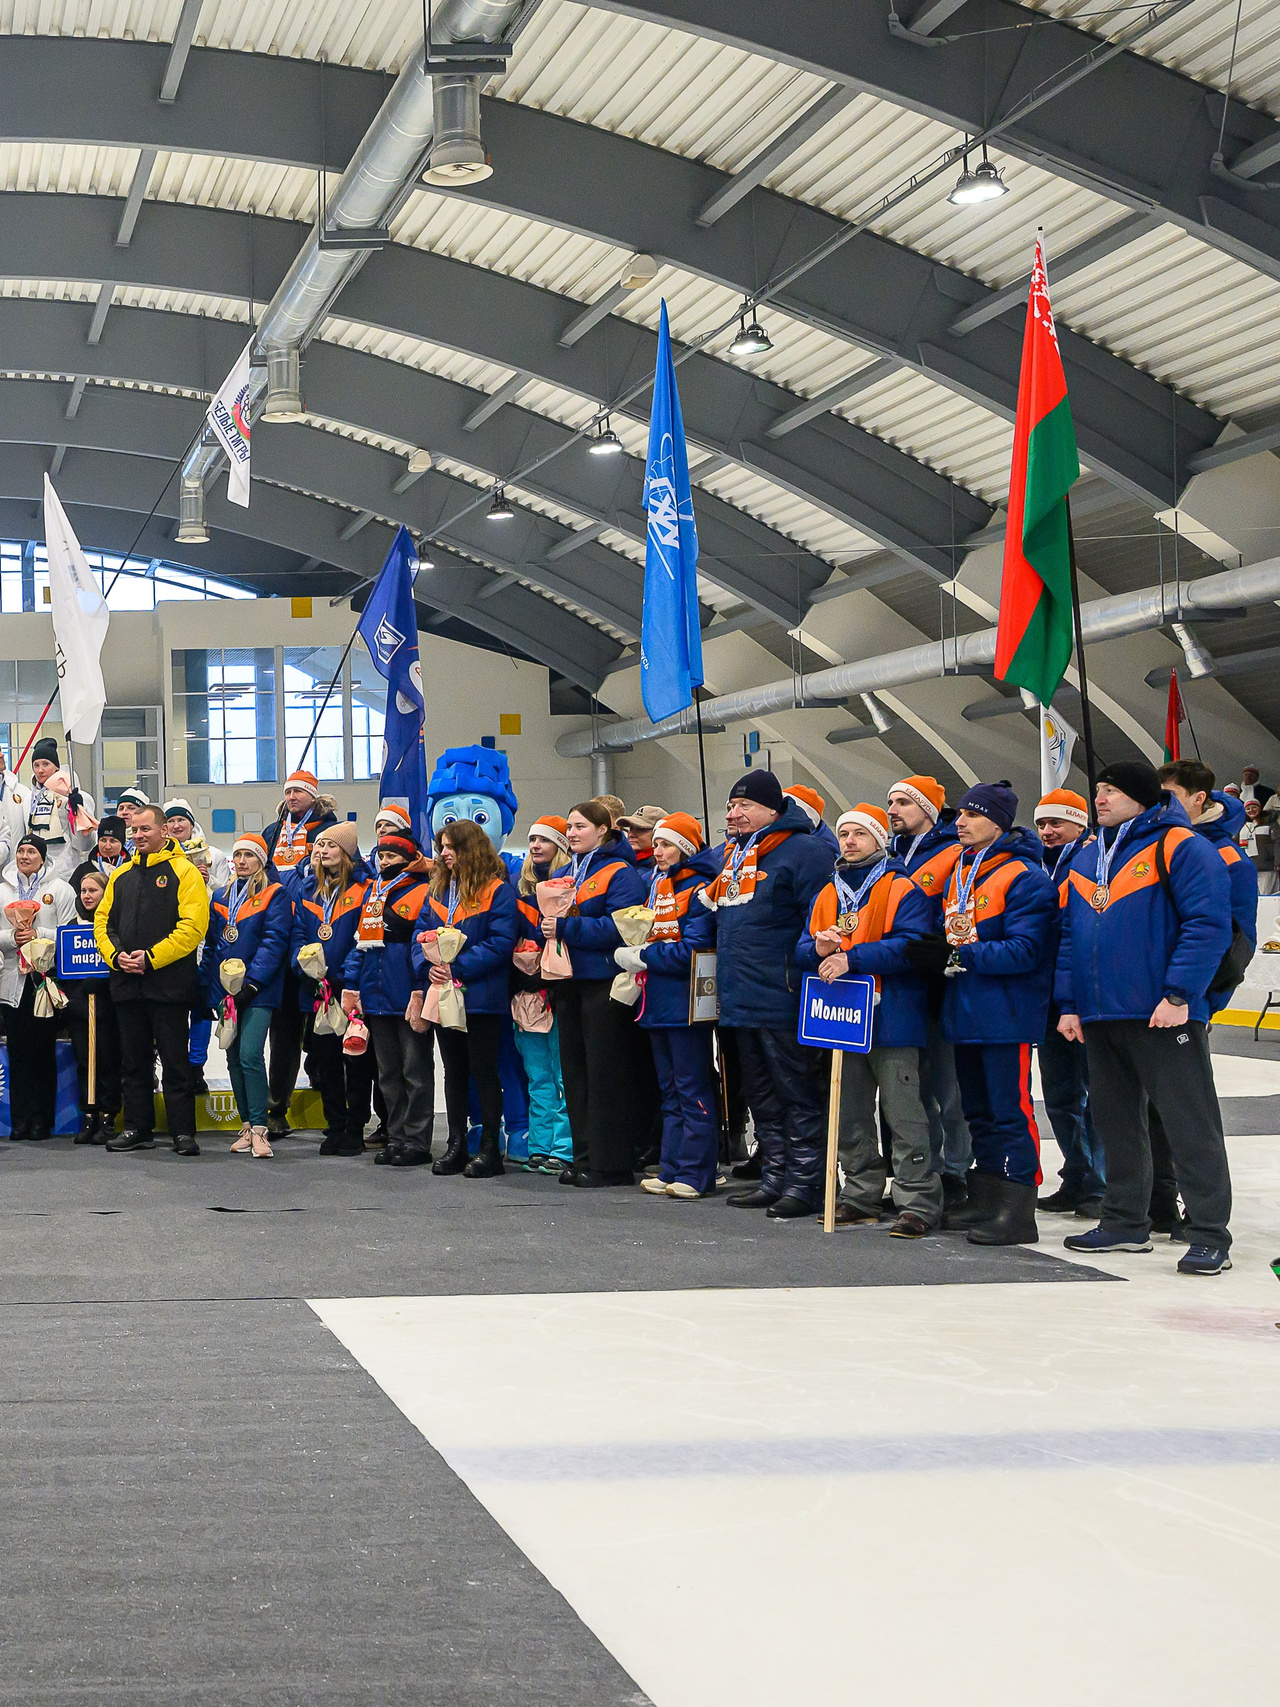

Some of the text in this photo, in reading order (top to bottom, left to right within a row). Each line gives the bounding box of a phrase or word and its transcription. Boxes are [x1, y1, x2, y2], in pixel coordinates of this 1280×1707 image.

[214, 400, 234, 435] БЕЛЫЕ
[228, 430, 251, 463] ТИГРЫ
[904, 787, 933, 814] БЕЛАРУСЬ
[968, 801, 989, 813] MOAX
[73, 935, 98, 949] Бел
[810, 997, 862, 1025] Молния
